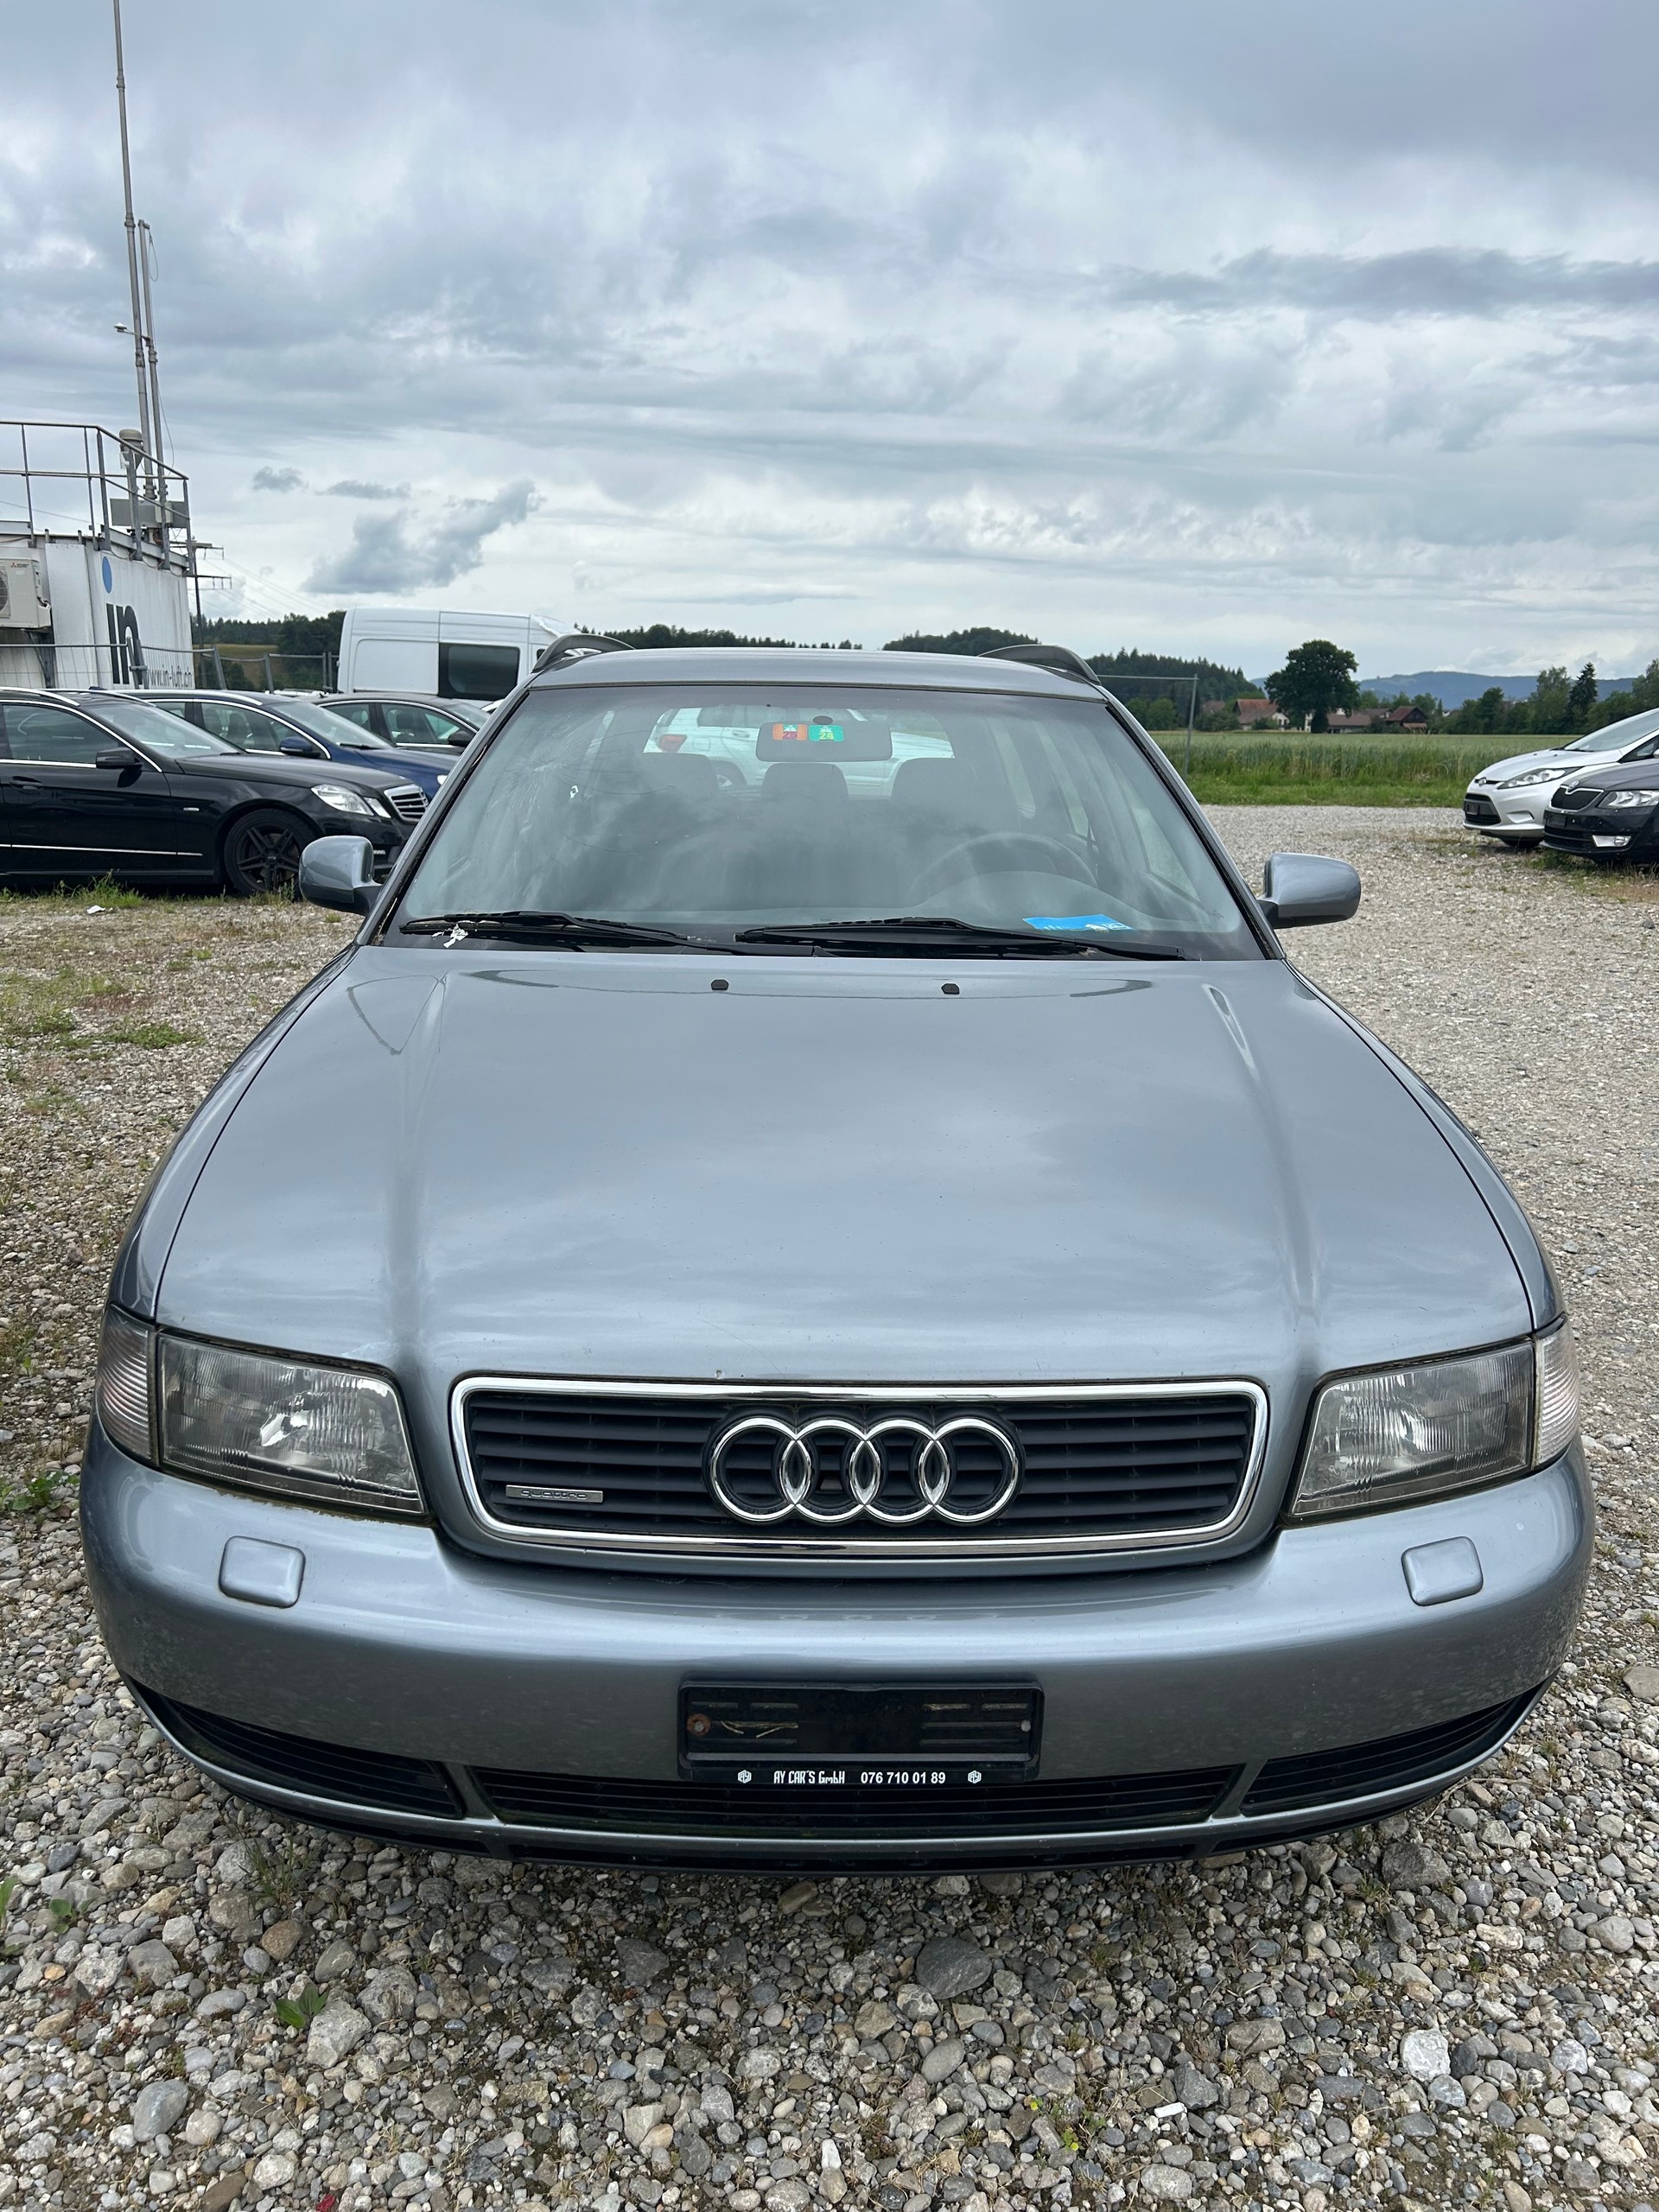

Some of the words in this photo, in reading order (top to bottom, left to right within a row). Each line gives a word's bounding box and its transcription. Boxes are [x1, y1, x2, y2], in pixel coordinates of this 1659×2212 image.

[773, 1770, 785, 1783] AY
[818, 1770, 846, 1784] GmbH
[861, 1771, 883, 1783] 076
[887, 1771, 909, 1783] 710
[912, 1771, 926, 1783] 01
[931, 1771, 946, 1783] 89
